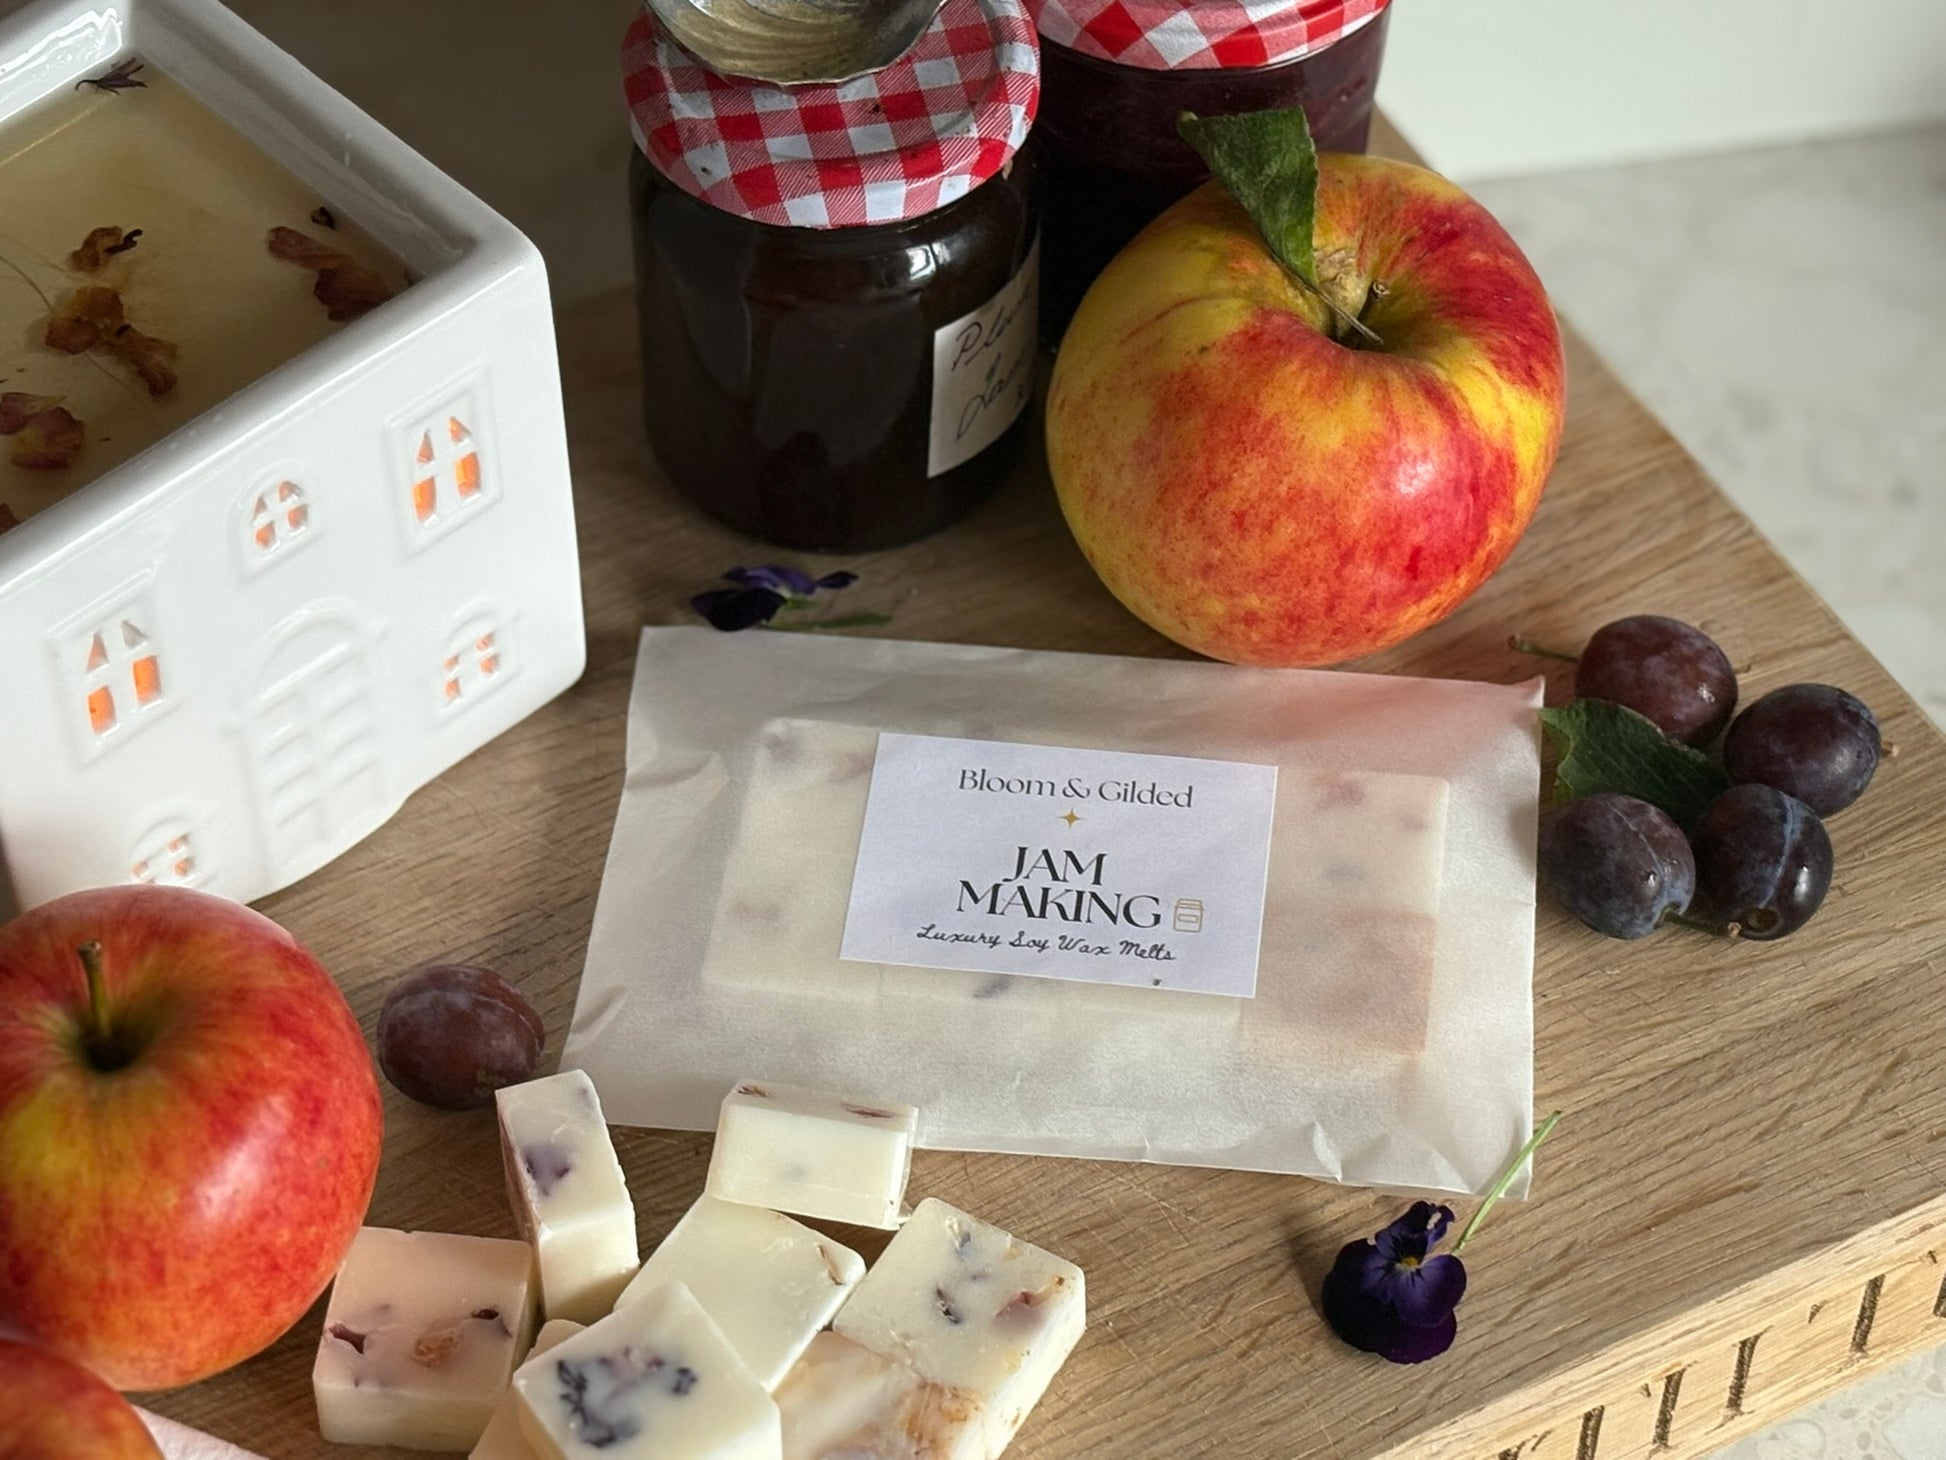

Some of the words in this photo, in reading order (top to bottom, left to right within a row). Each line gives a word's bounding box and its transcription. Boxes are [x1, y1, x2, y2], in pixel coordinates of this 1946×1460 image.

[958, 767, 1055, 797] Bloom
[1062, 777, 1091, 799] &
[1097, 780, 1194, 808] Gilded
[1001, 845, 1108, 886] JAM
[956, 879, 1162, 929] MAKING
[916, 923, 1003, 950] Luxury
[1008, 930, 1051, 953] Soy
[1057, 934, 1111, 956] Wax
[1118, 939, 1177, 962] Melts
